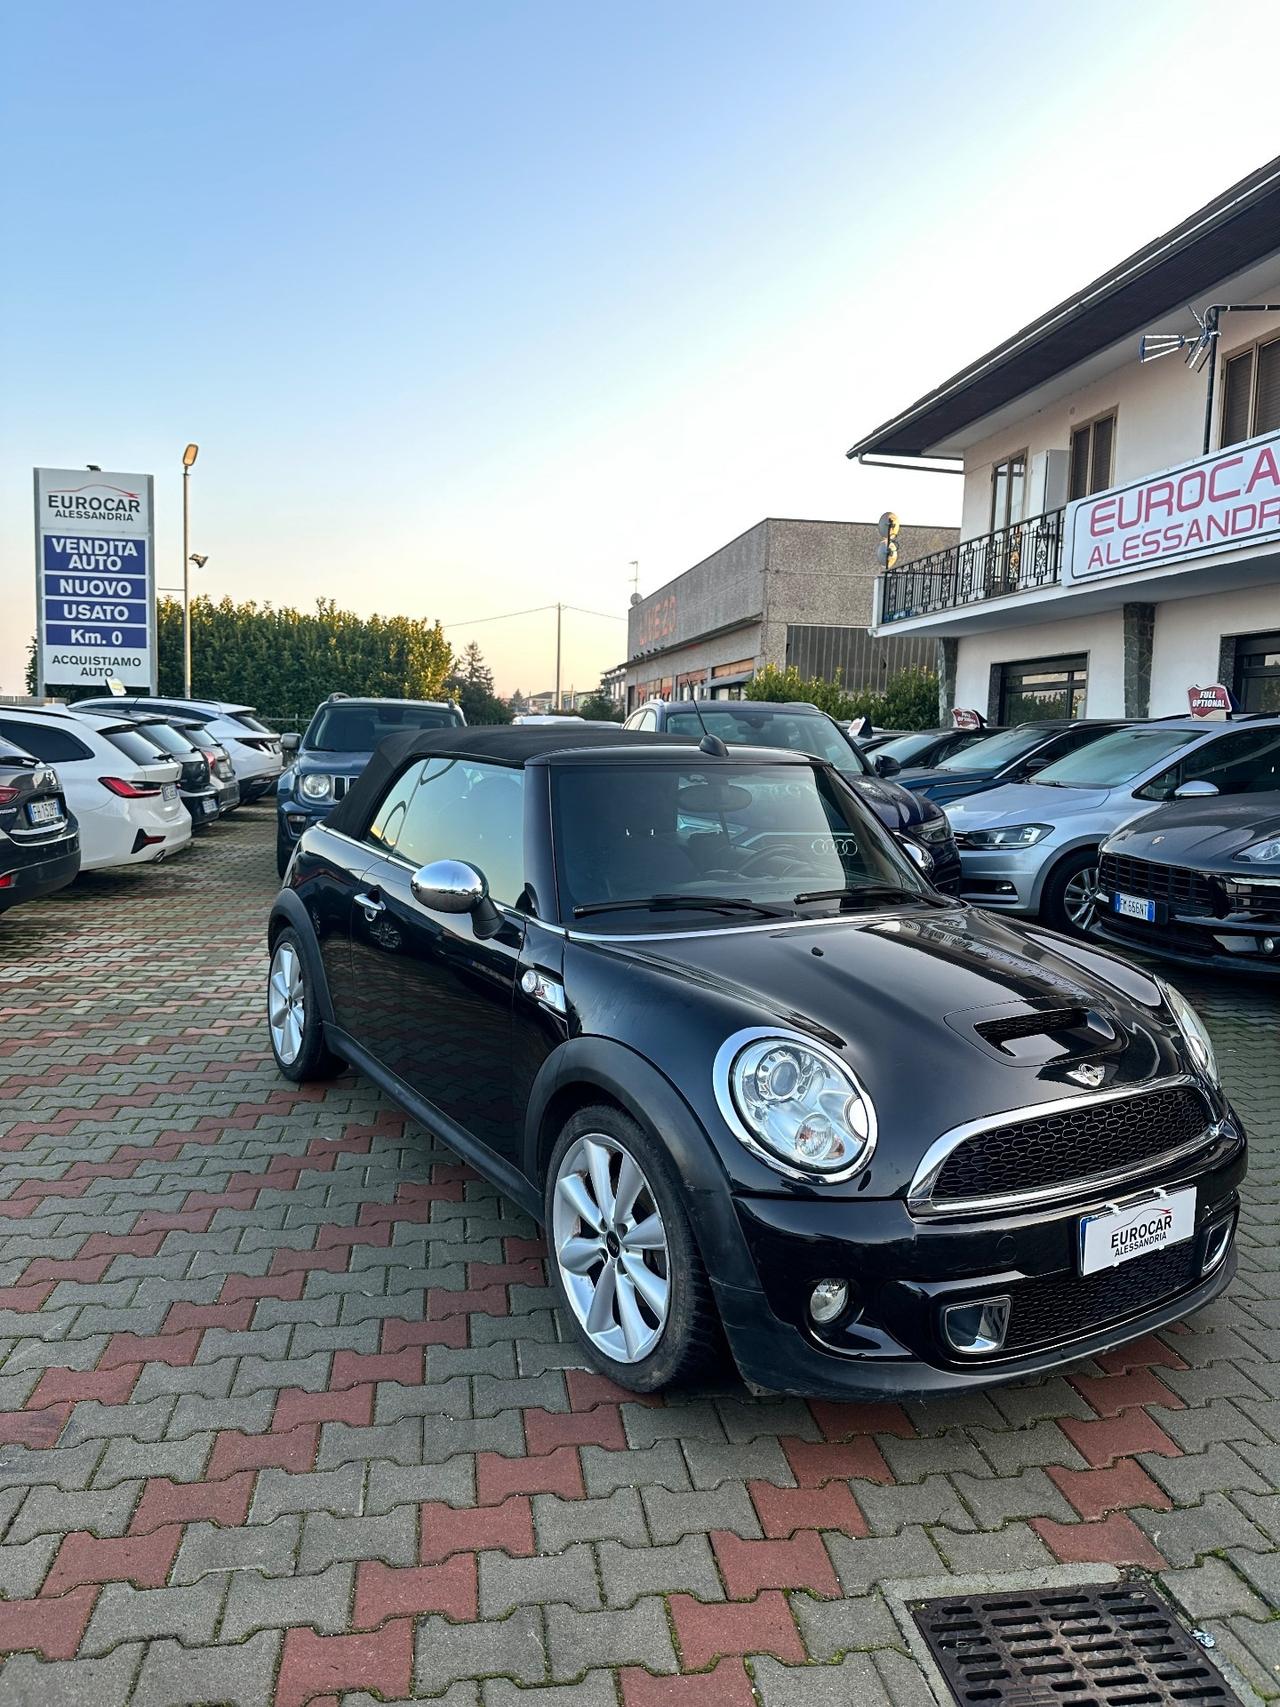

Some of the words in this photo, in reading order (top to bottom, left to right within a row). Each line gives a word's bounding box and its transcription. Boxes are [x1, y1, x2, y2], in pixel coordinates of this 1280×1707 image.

[1090, 447, 1280, 538] EUROCA
[48, 495, 140, 513] EUROCAR
[55, 510, 134, 522] ALESSANDRIA
[1087, 496, 1280, 570] ALESSANDR
[52, 537, 137, 557] VENDITA
[68, 555, 122, 572] AUTO
[59, 578, 132, 597] NUOVO
[63, 603, 129, 621] USATO
[70, 628, 107, 644] Km.
[111, 630, 123, 645] 0
[52, 655, 142, 667] ACQUISTIAMO
[80, 666, 114, 678] AUTO
[1192, 699, 1226, 708] OPTIONAL
[1199, 691, 1216, 699] FULL
[1111, 1216, 1172, 1249] EUROCAR
[1114, 1231, 1167, 1258] ALESSANDRIA
